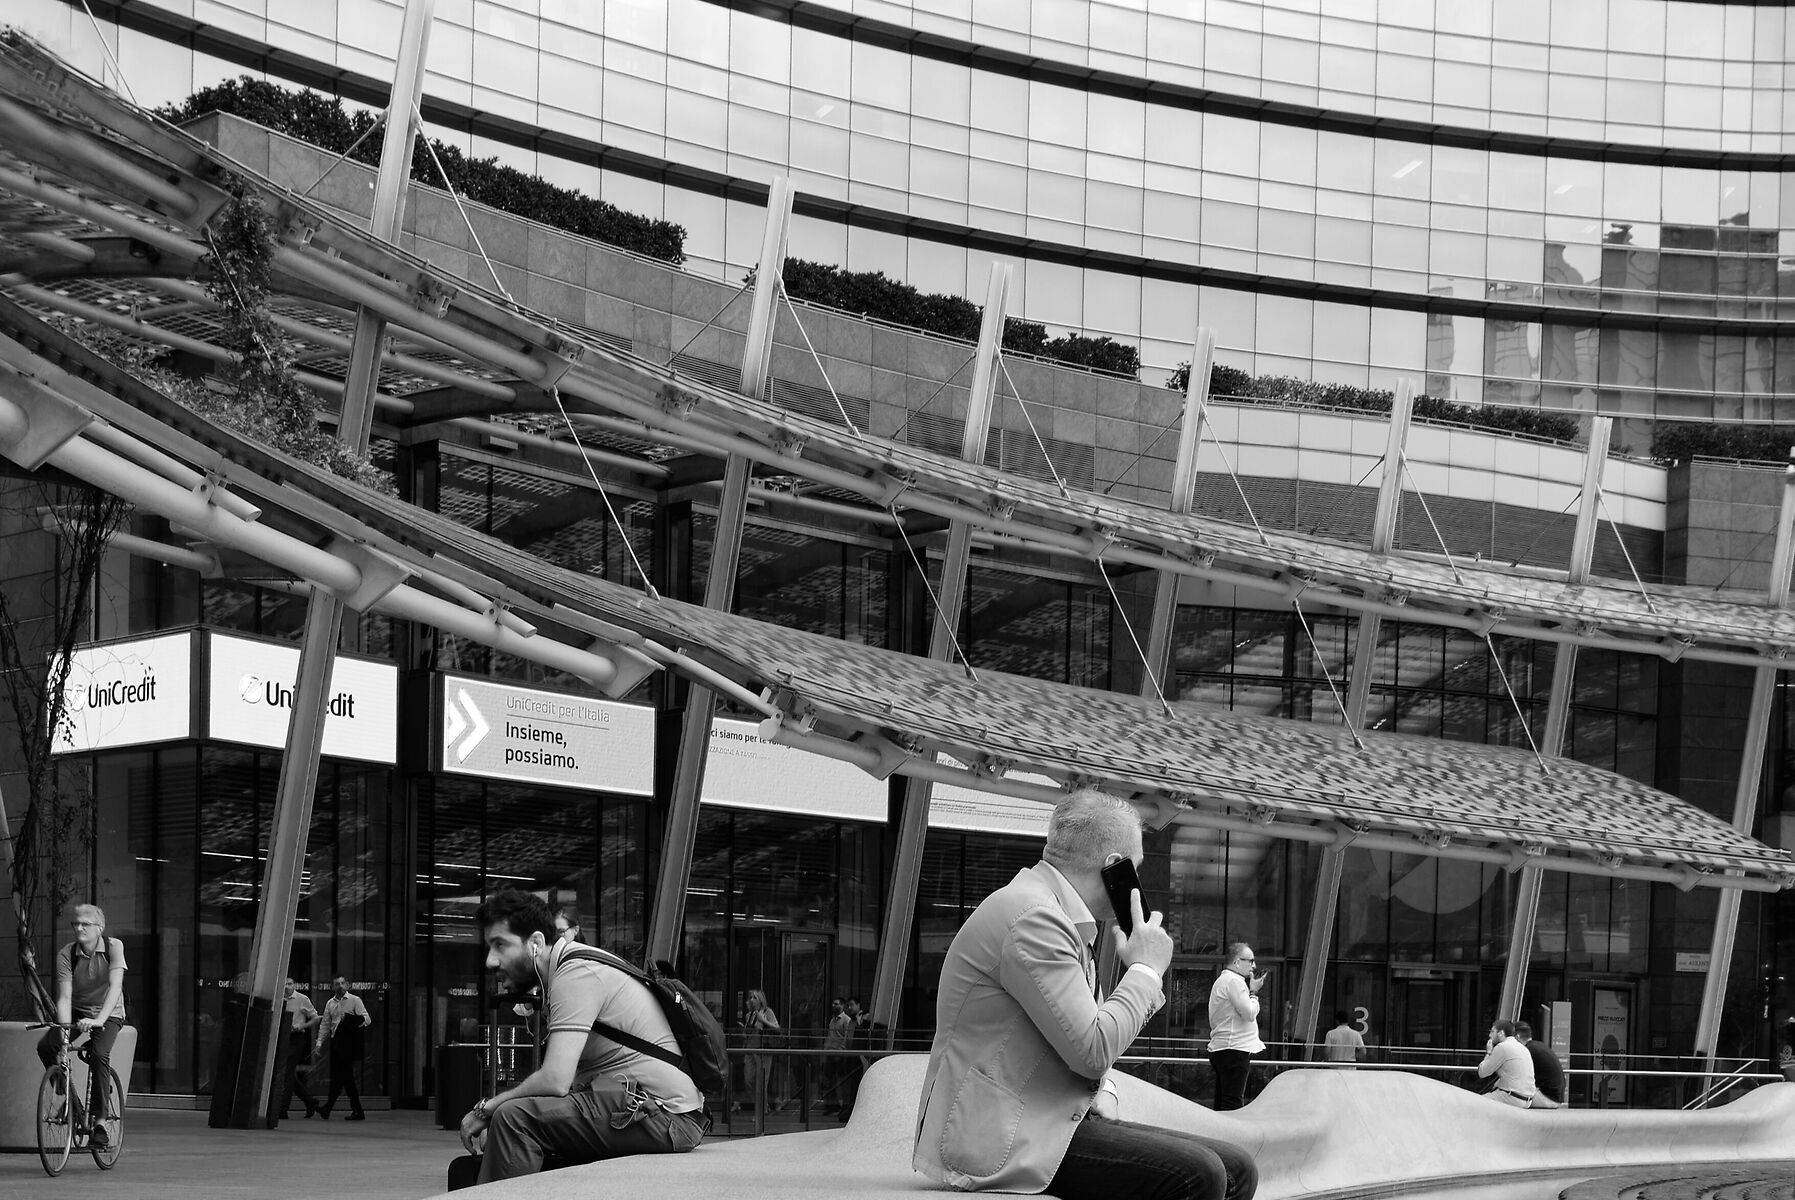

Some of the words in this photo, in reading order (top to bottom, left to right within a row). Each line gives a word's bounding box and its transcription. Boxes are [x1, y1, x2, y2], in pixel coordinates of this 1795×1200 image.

[88, 676, 156, 708] UniCredit
[266, 681, 354, 718] Undit
[506, 696, 556, 715] UniCredit
[559, 705, 575, 718] per
[578, 705, 610, 722] l'Italia
[506, 721, 567, 748] Insieme,
[719, 729, 743, 741] siamo
[744, 734, 758, 744] per
[505, 748, 579, 769] possiamo.
[1354, 1006, 1369, 1036] 3
